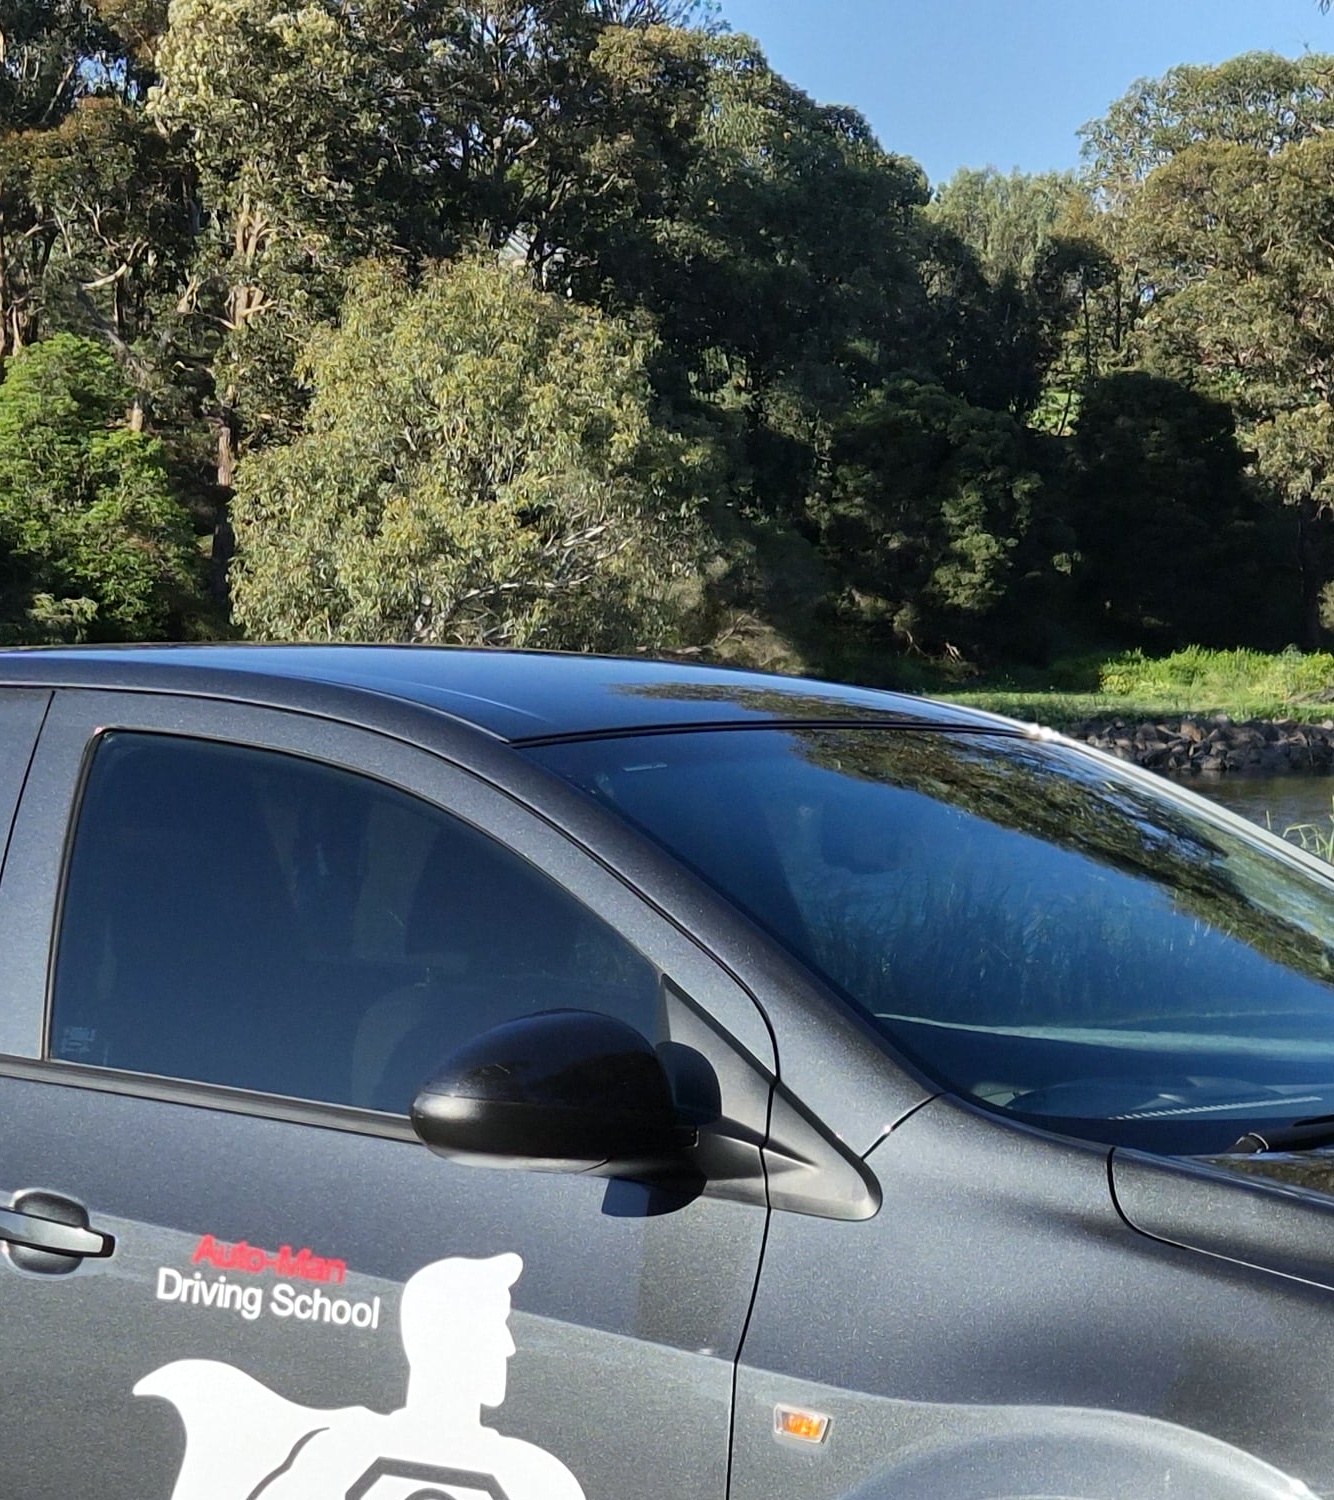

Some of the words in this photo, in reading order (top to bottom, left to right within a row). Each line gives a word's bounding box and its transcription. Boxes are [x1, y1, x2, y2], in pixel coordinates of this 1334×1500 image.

[191, 1234, 347, 1284] Auto-Man
[156, 1266, 263, 1320] Driving
[270, 1283, 381, 1330] School
